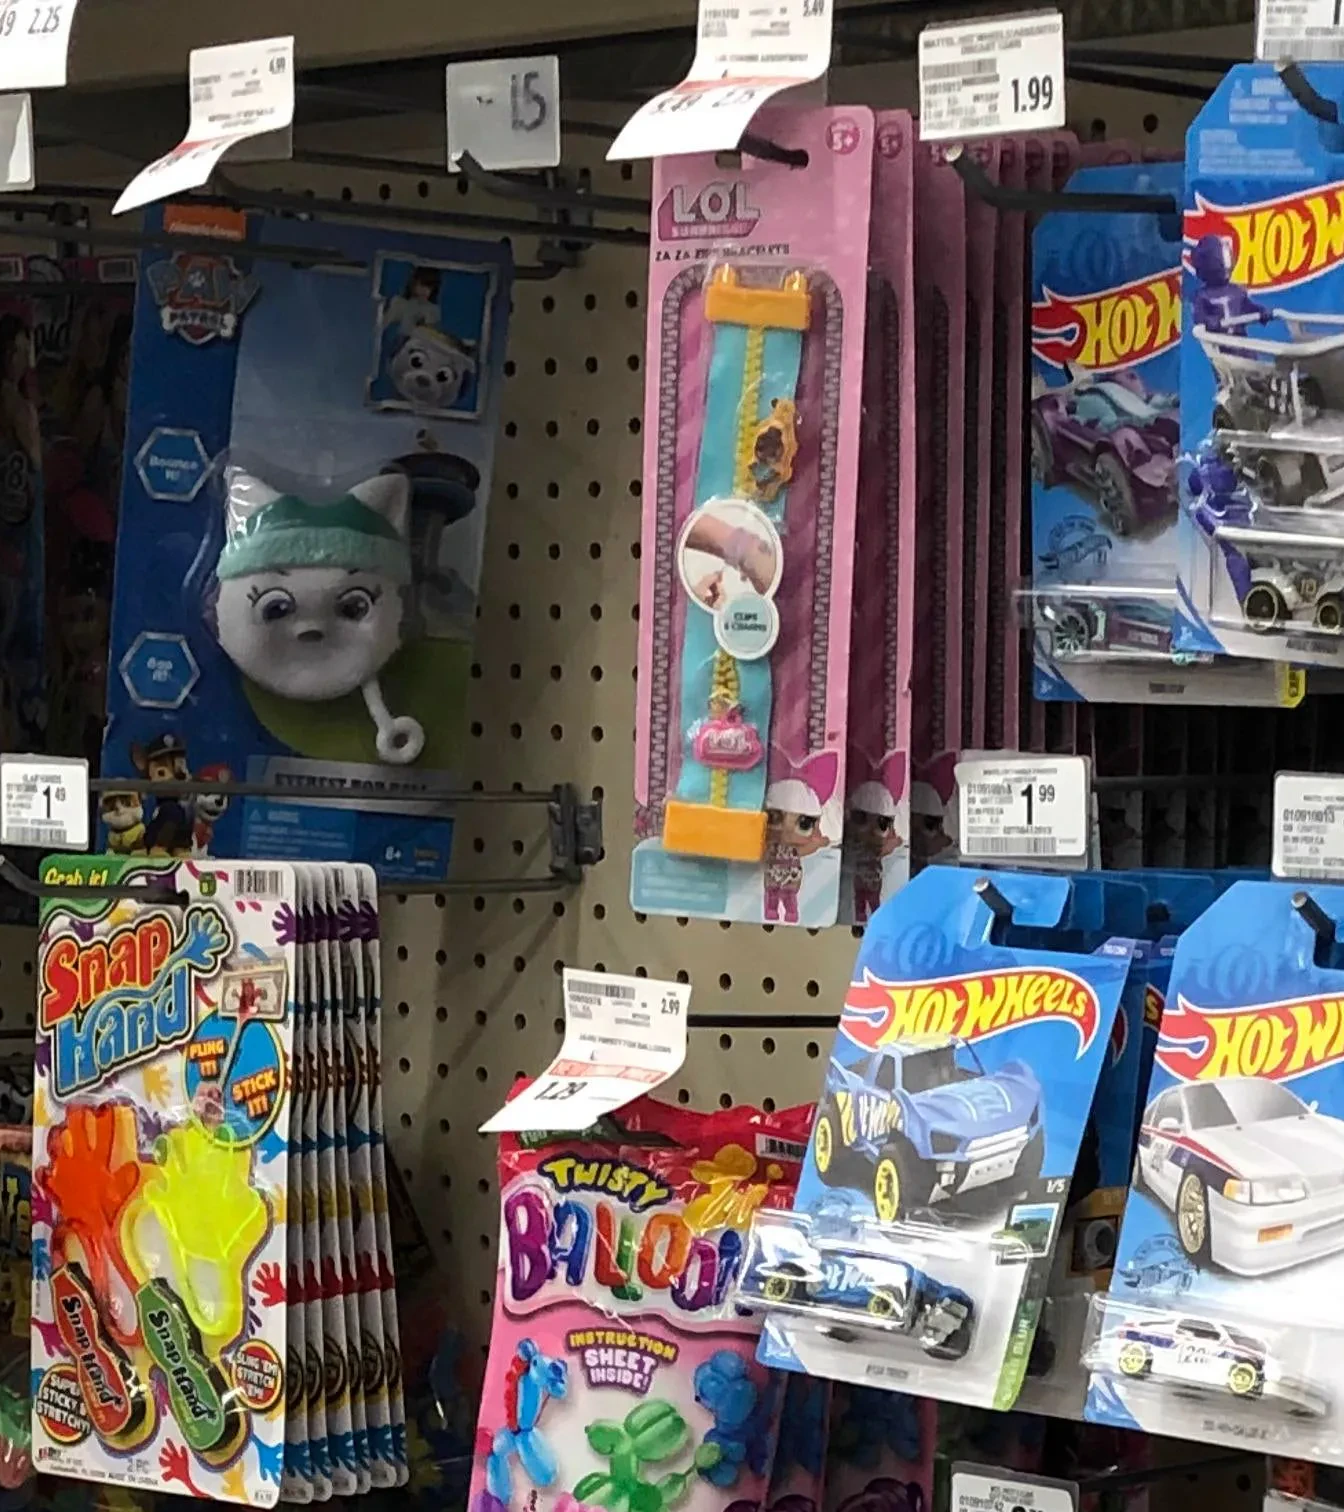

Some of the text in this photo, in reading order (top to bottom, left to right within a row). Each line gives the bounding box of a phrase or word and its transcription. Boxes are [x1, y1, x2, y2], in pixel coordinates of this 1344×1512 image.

[1011, 75, 1053, 113] 1.99
[44, 918, 172, 1024] Snap
[58, 964, 186, 1091] Hand
[232, 1074, 276, 1102] STICK
[544, 1158, 669, 1205] TWISTY
[569, 1331, 677, 1361] INSTRUCTION
[585, 1349, 656, 1373] SHEET
[590, 1366, 650, 1388] INSIDE!
